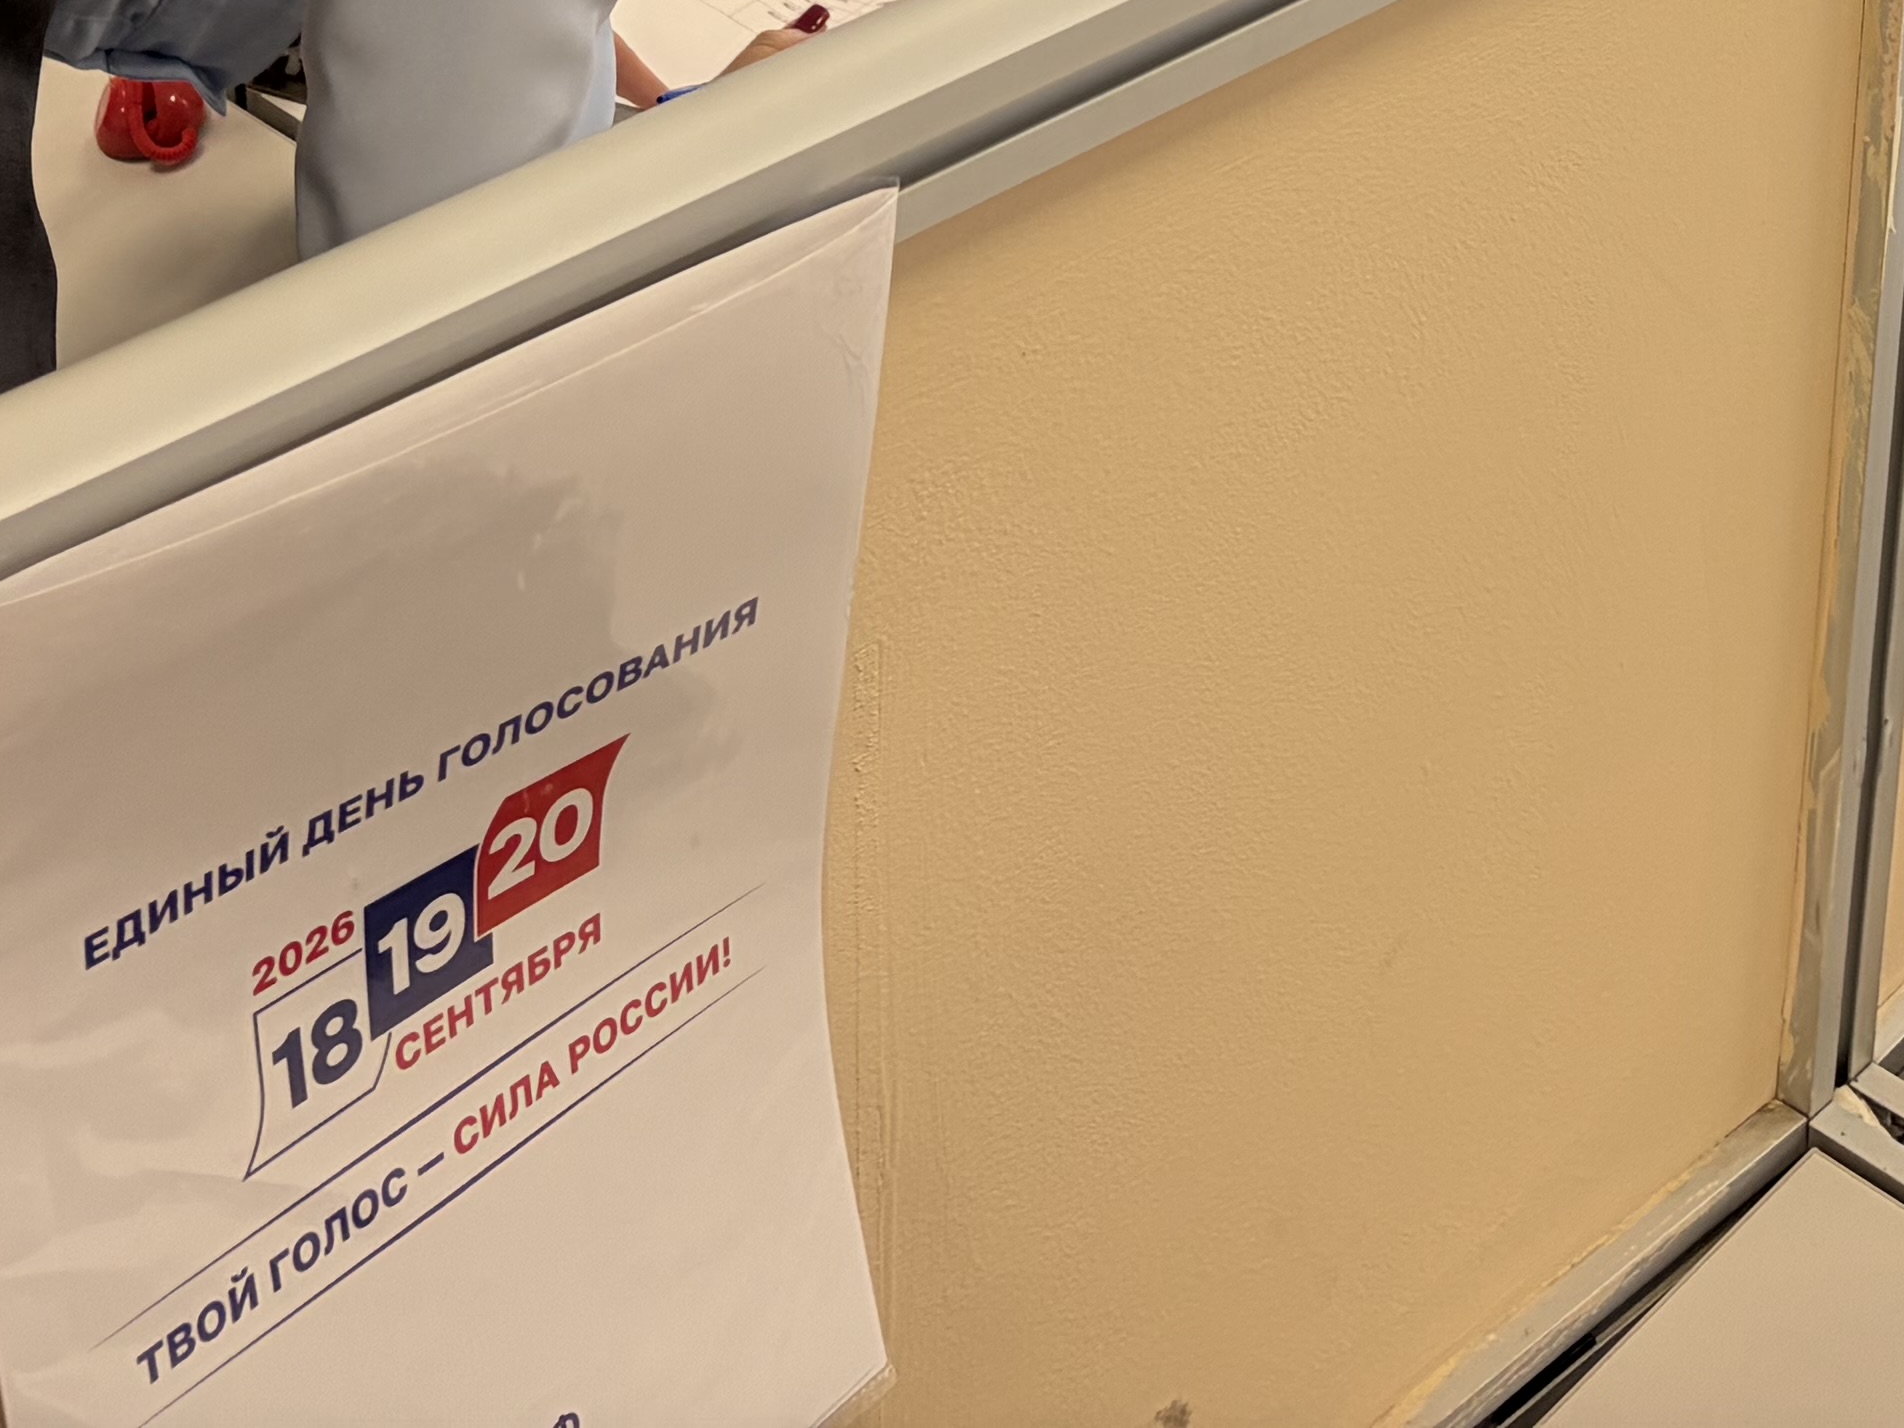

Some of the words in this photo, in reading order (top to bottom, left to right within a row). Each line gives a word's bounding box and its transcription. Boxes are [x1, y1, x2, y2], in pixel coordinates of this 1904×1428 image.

[83, 826, 289, 971] ЕДИНЫЙ
[302, 770, 424, 857] ДЕНЬ
[437, 596, 759, 782] ГОЛОСОВАНИЯ
[486, 786, 594, 901] 20
[251, 910, 356, 996] 2026
[376, 892, 466, 996] 19
[395, 913, 602, 1071] СЕНТЯБРЯ
[271, 998, 363, 1110] 18
[136, 1267, 259, 1385] ТВОЙ
[268, 1167, 408, 1293] ГОЛОС
[454, 1060, 560, 1155] СИЛА
[567, 936, 732, 1075] РОССИИ!
